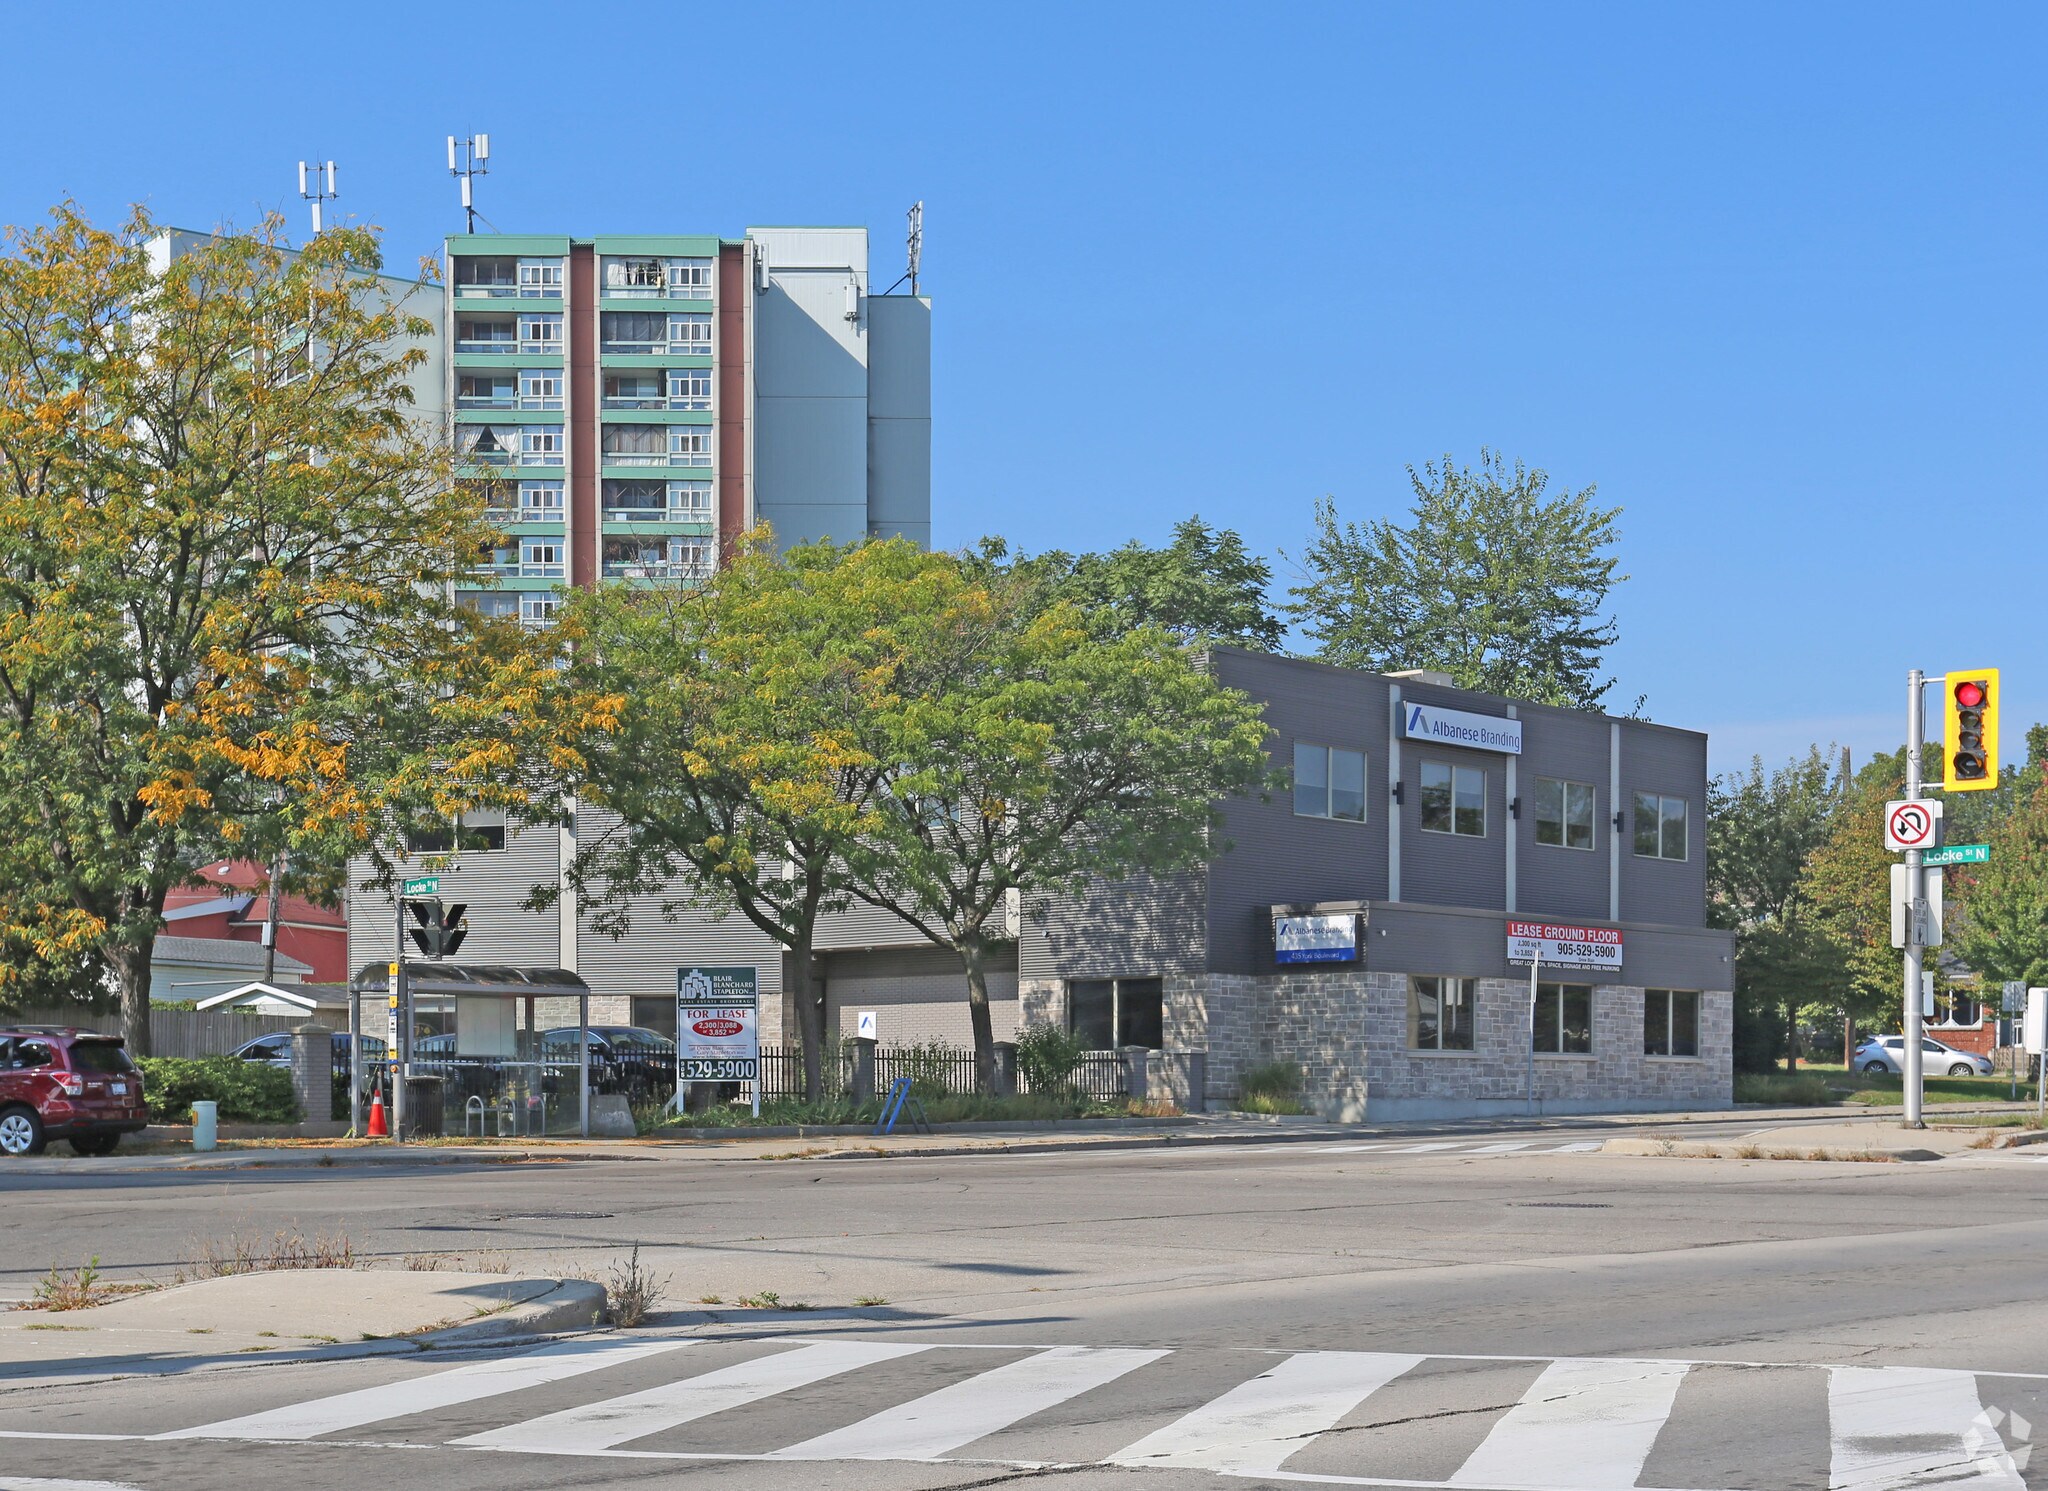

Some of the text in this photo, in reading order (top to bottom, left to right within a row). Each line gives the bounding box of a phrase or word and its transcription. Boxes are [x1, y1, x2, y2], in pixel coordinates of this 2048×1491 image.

[1433, 721, 1520, 752] Albanese Branding
[1926, 850, 1963, 861] Locke
[1975, 848, 1985, 859] N
[406, 882, 426, 893] Locke
[432, 881, 437, 890] N
[1511, 924, 1618, 943] LEASE GROUND FLOOR
[688, 1010, 747, 1018] FOR LEASE
[686, 1060, 755, 1078] 529-5900
